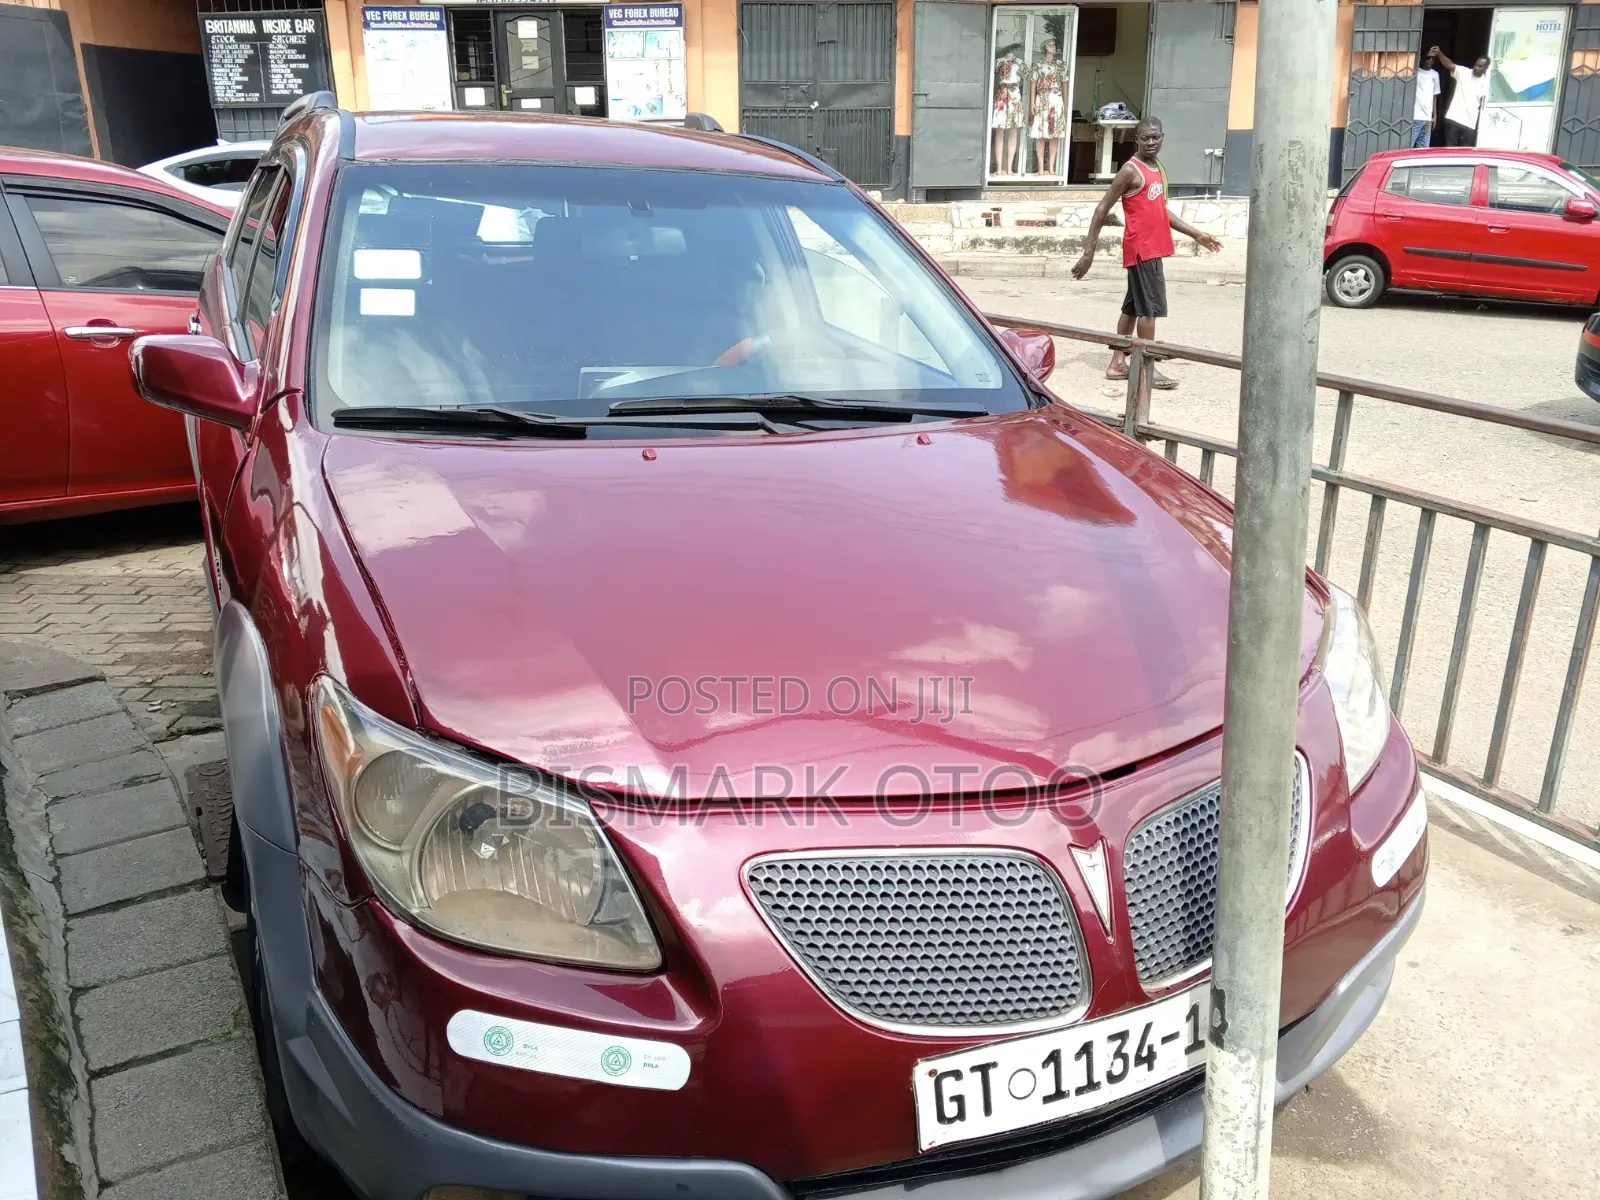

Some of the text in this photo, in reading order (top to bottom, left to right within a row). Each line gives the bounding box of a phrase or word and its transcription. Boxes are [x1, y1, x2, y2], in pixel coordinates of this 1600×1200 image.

[365, 11, 440, 20] VEC FOREX BUREAU
[608, 8, 679, 18] VEC FOREX BUREAU
[205, 18, 315, 34] BRITANNIA INSIDE BAR
[1536, 23, 1562, 31] HOTEL
[933, 1060, 999, 1126] GT
